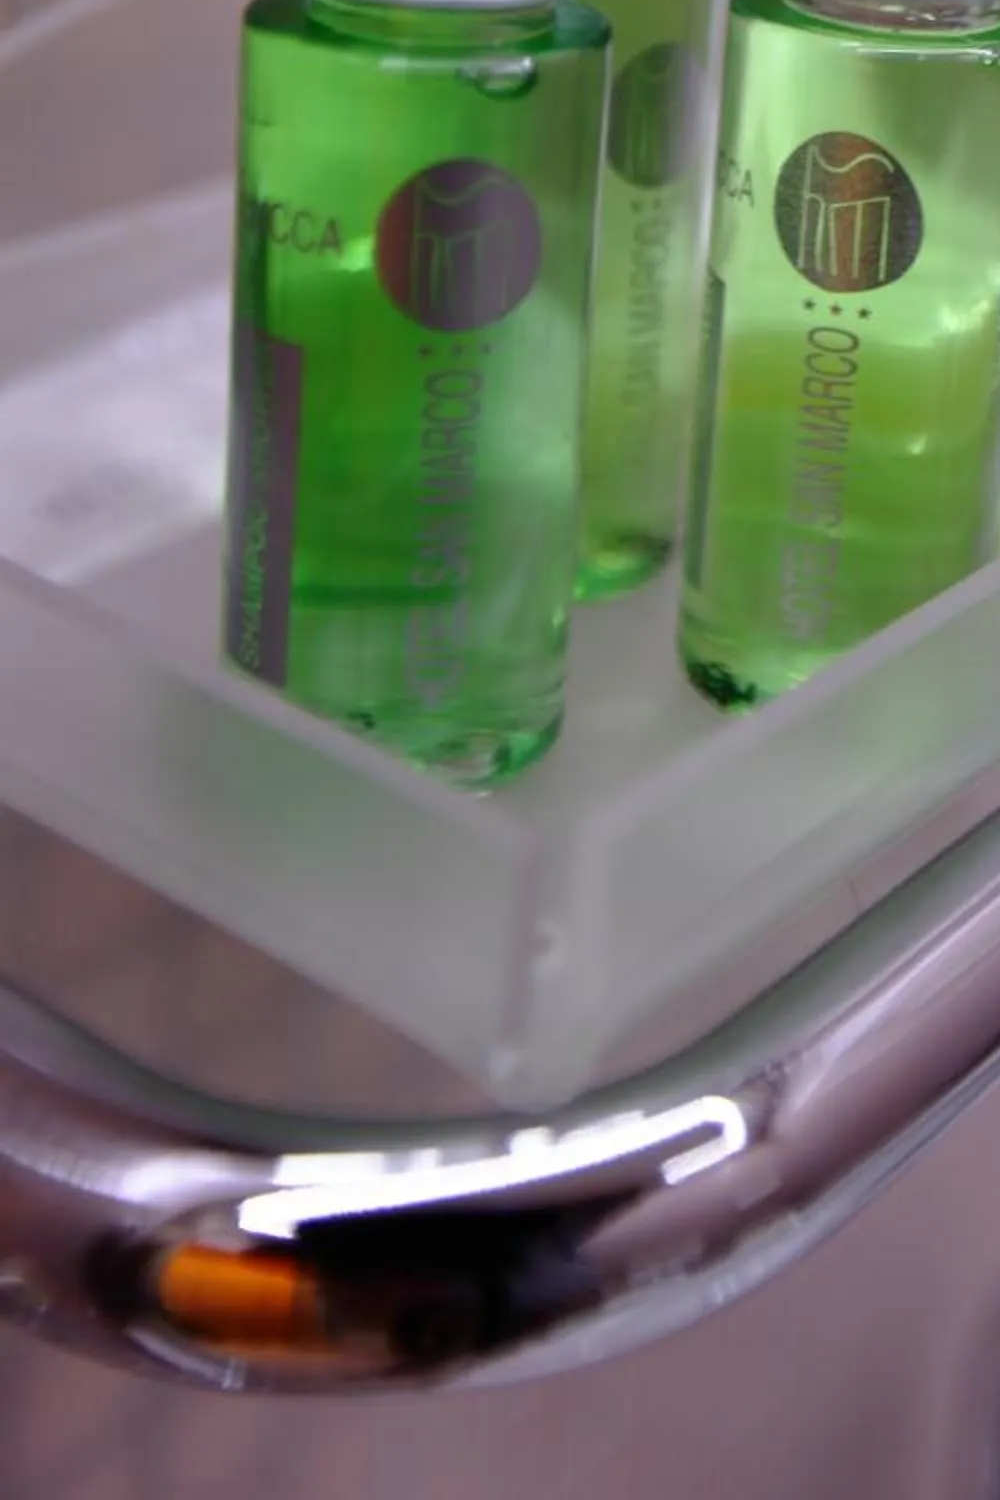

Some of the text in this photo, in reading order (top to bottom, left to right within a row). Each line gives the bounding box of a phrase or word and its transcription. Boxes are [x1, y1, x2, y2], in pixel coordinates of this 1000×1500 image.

[416, 369, 482, 506] MARCO
[798, 326, 859, 450] MARCO
[788, 457, 846, 527] SAN
